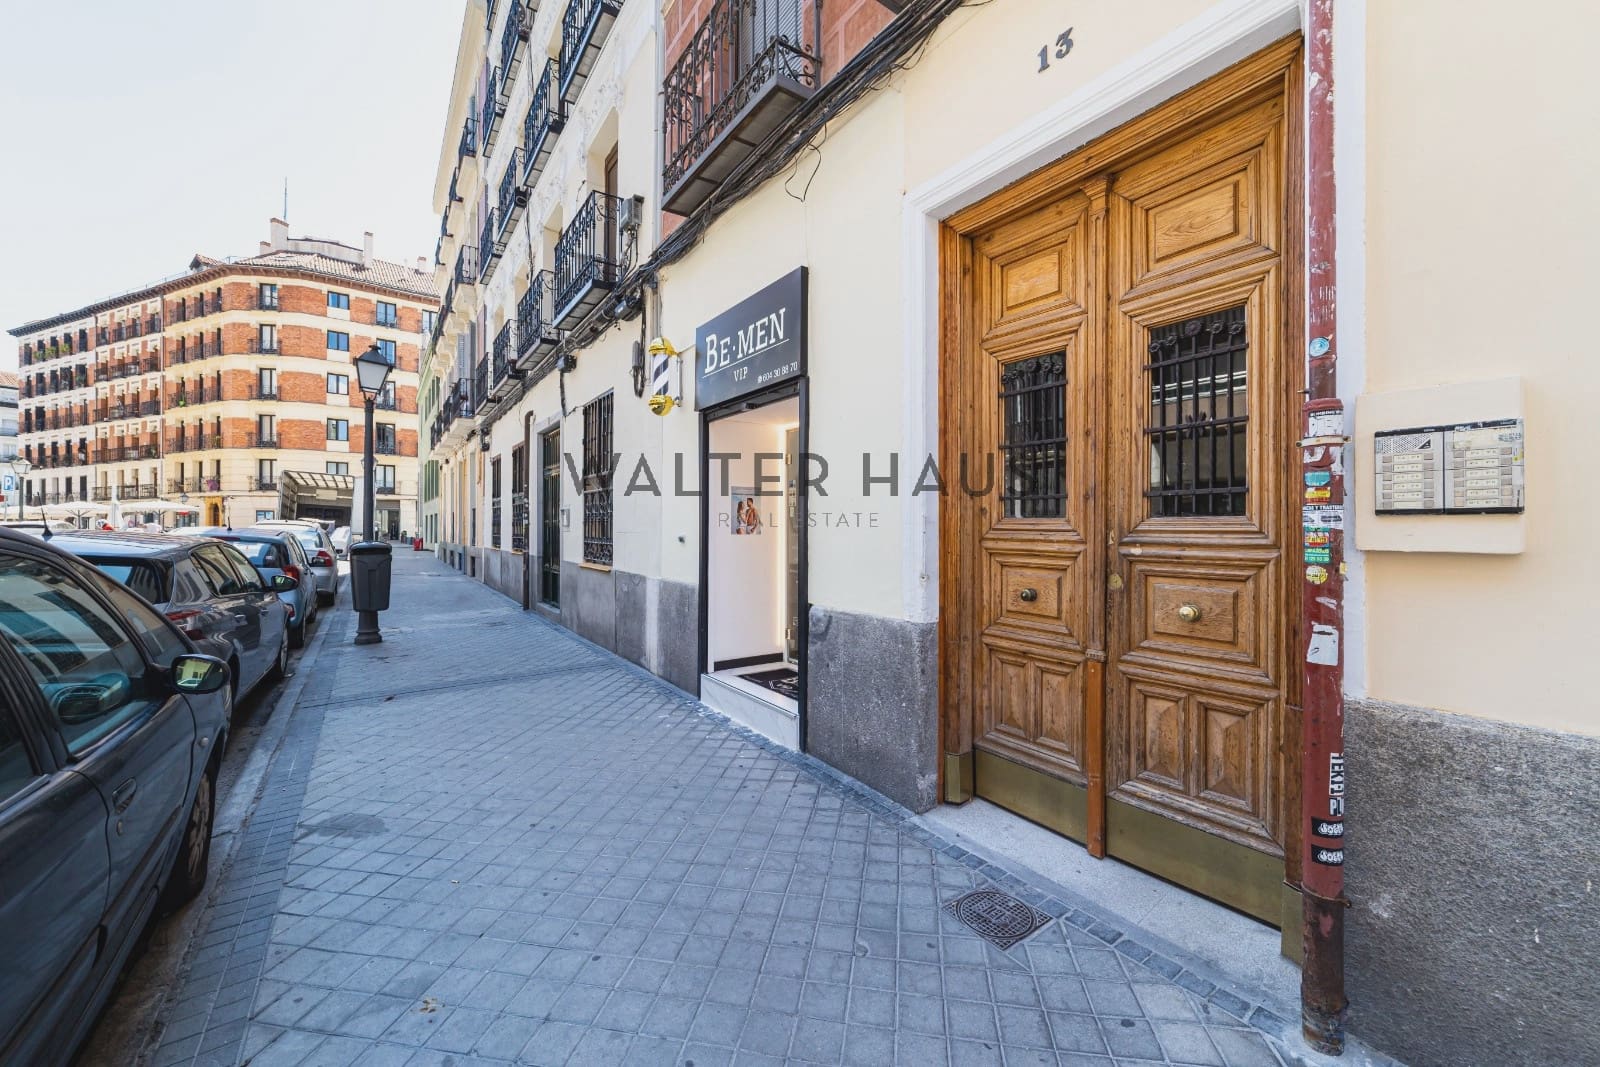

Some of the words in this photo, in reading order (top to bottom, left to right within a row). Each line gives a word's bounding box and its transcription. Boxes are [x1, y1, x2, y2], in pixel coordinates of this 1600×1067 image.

[1037, 27, 1074, 74] 13
[734, 367, 748, 383] VIP
[5, 476, 12, 490] P
